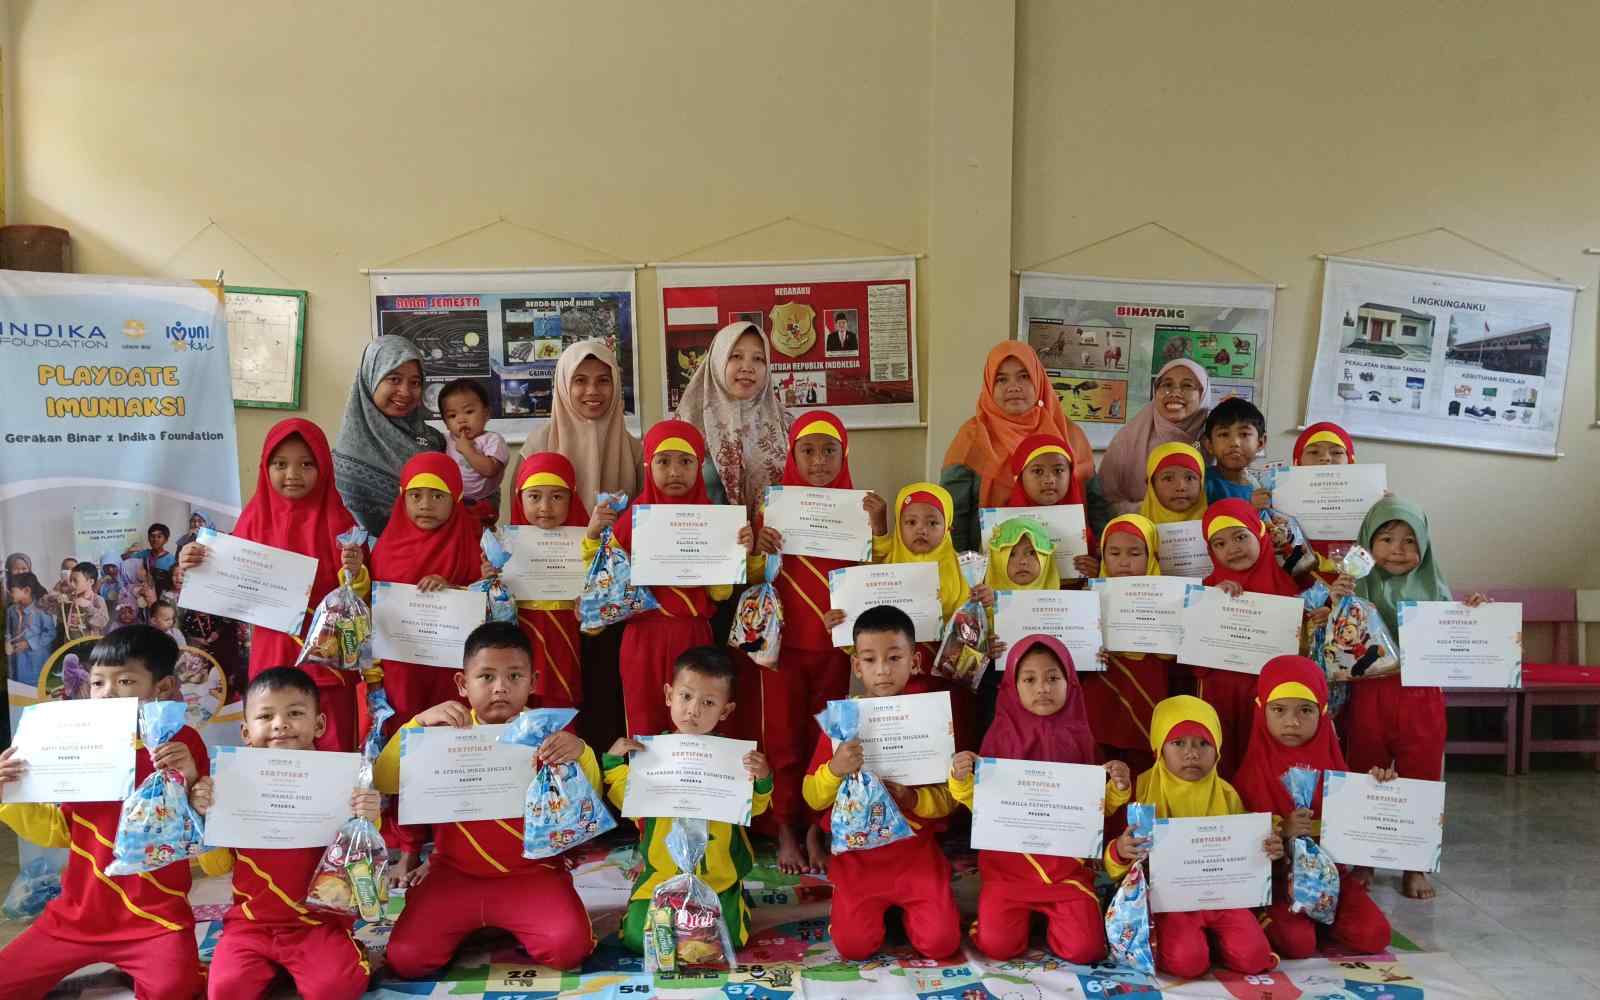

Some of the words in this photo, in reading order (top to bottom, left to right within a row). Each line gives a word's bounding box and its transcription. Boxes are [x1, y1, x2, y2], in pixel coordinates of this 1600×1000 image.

[774, 287, 811, 296] NEGARAKU
[431, 296, 480, 308] SEMESTA
[1411, 295, 1486, 312] LINGKUNGANKU
[1116, 306, 1185, 319] BINATANG
[0, 320, 106, 339] INDIKA
[0, 337, 108, 349] FOUNDATION
[792, 361, 824, 370] REPUBLIK
[825, 359, 861, 369] INDONESIA
[38, 364, 180, 387] PLAYDATE
[46, 396, 186, 418] IMUNIAKSI
[5, 432, 61, 444] Gerakan
[67, 433, 101, 443] Binar
[106, 434, 114, 443] x
[119, 431, 155, 443] Indika
[160, 430, 224, 442] Foundation
[447, 744, 493, 754] SERTIFIKAT
[671, 751, 713, 759] SERTIFIKAT
[1016, 779, 1061, 789] SERTIFIKAT
[507, 969, 537, 979] 28
[727, 984, 758, 995] 57
